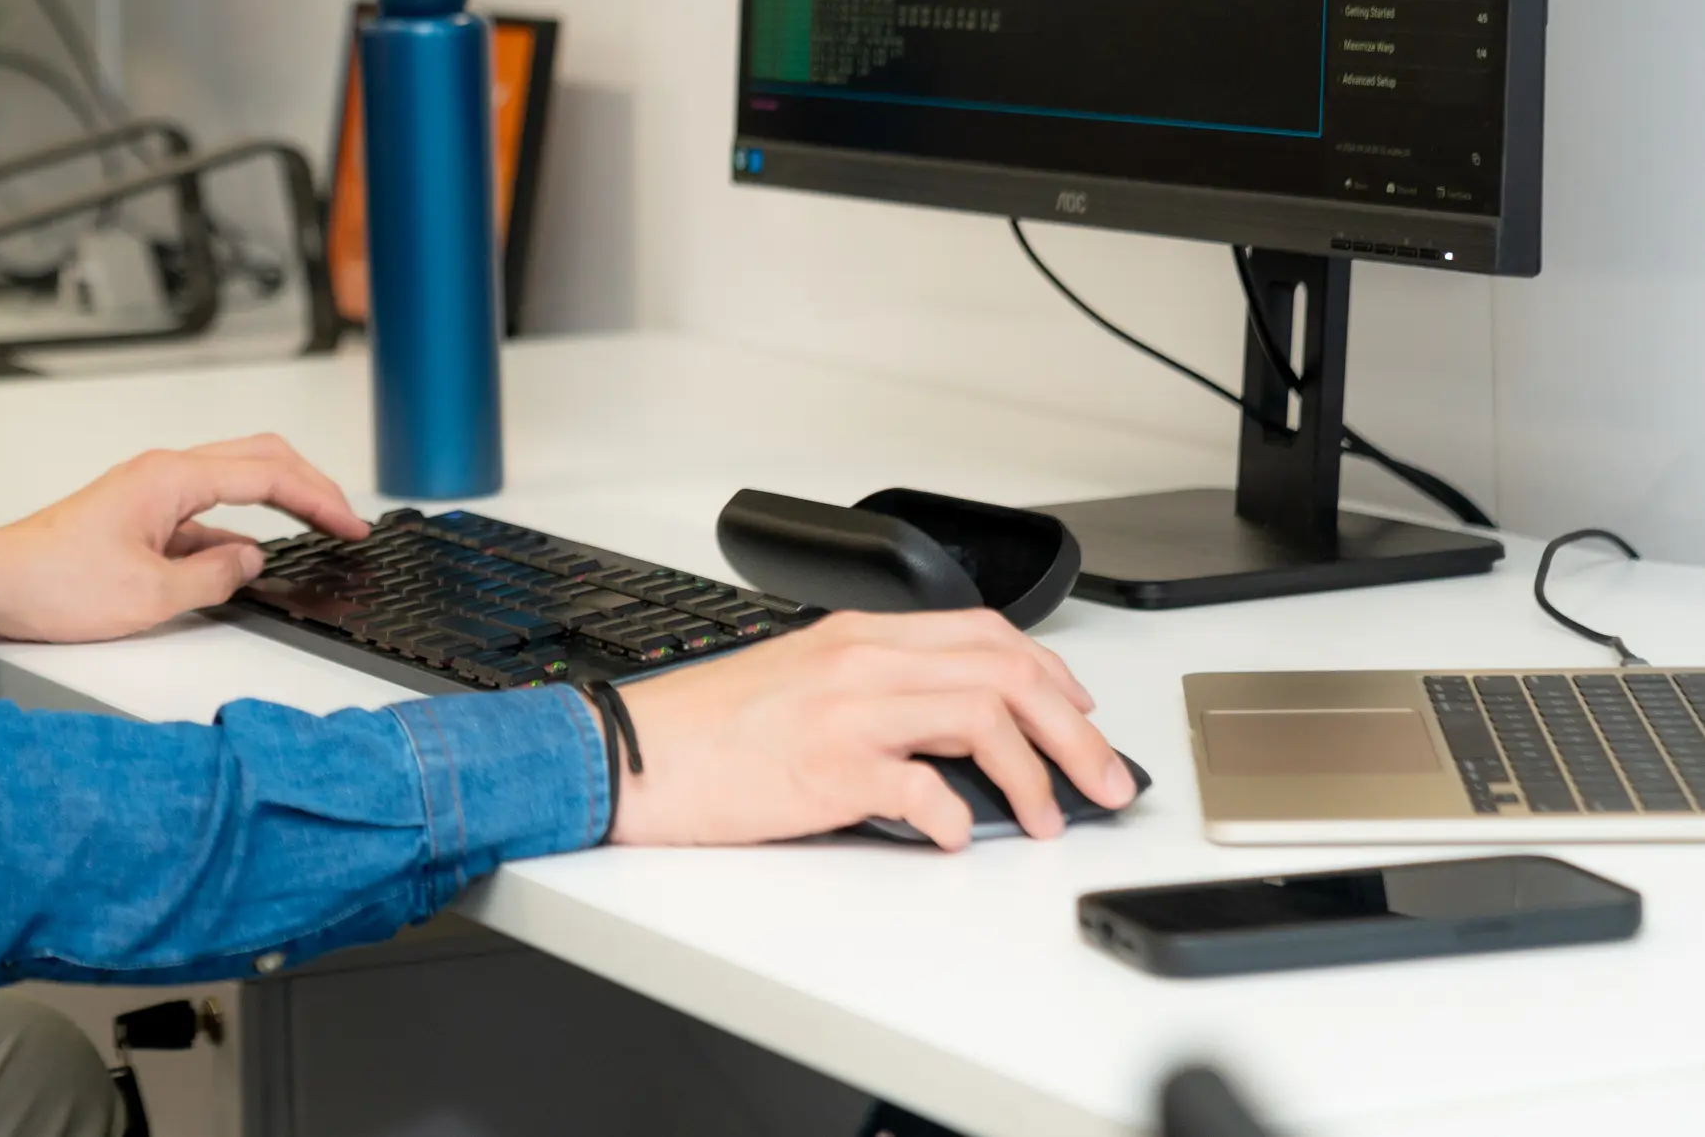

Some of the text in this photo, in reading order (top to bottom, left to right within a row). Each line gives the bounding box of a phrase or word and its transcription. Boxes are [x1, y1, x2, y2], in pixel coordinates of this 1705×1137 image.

[1345, 5, 1395, 19] Getting Started
[1344, 39, 1394, 53] Maximize Warp
[1343, 73, 1396, 88] Advanced Setup
[1055, 191, 1087, 215] AOC
